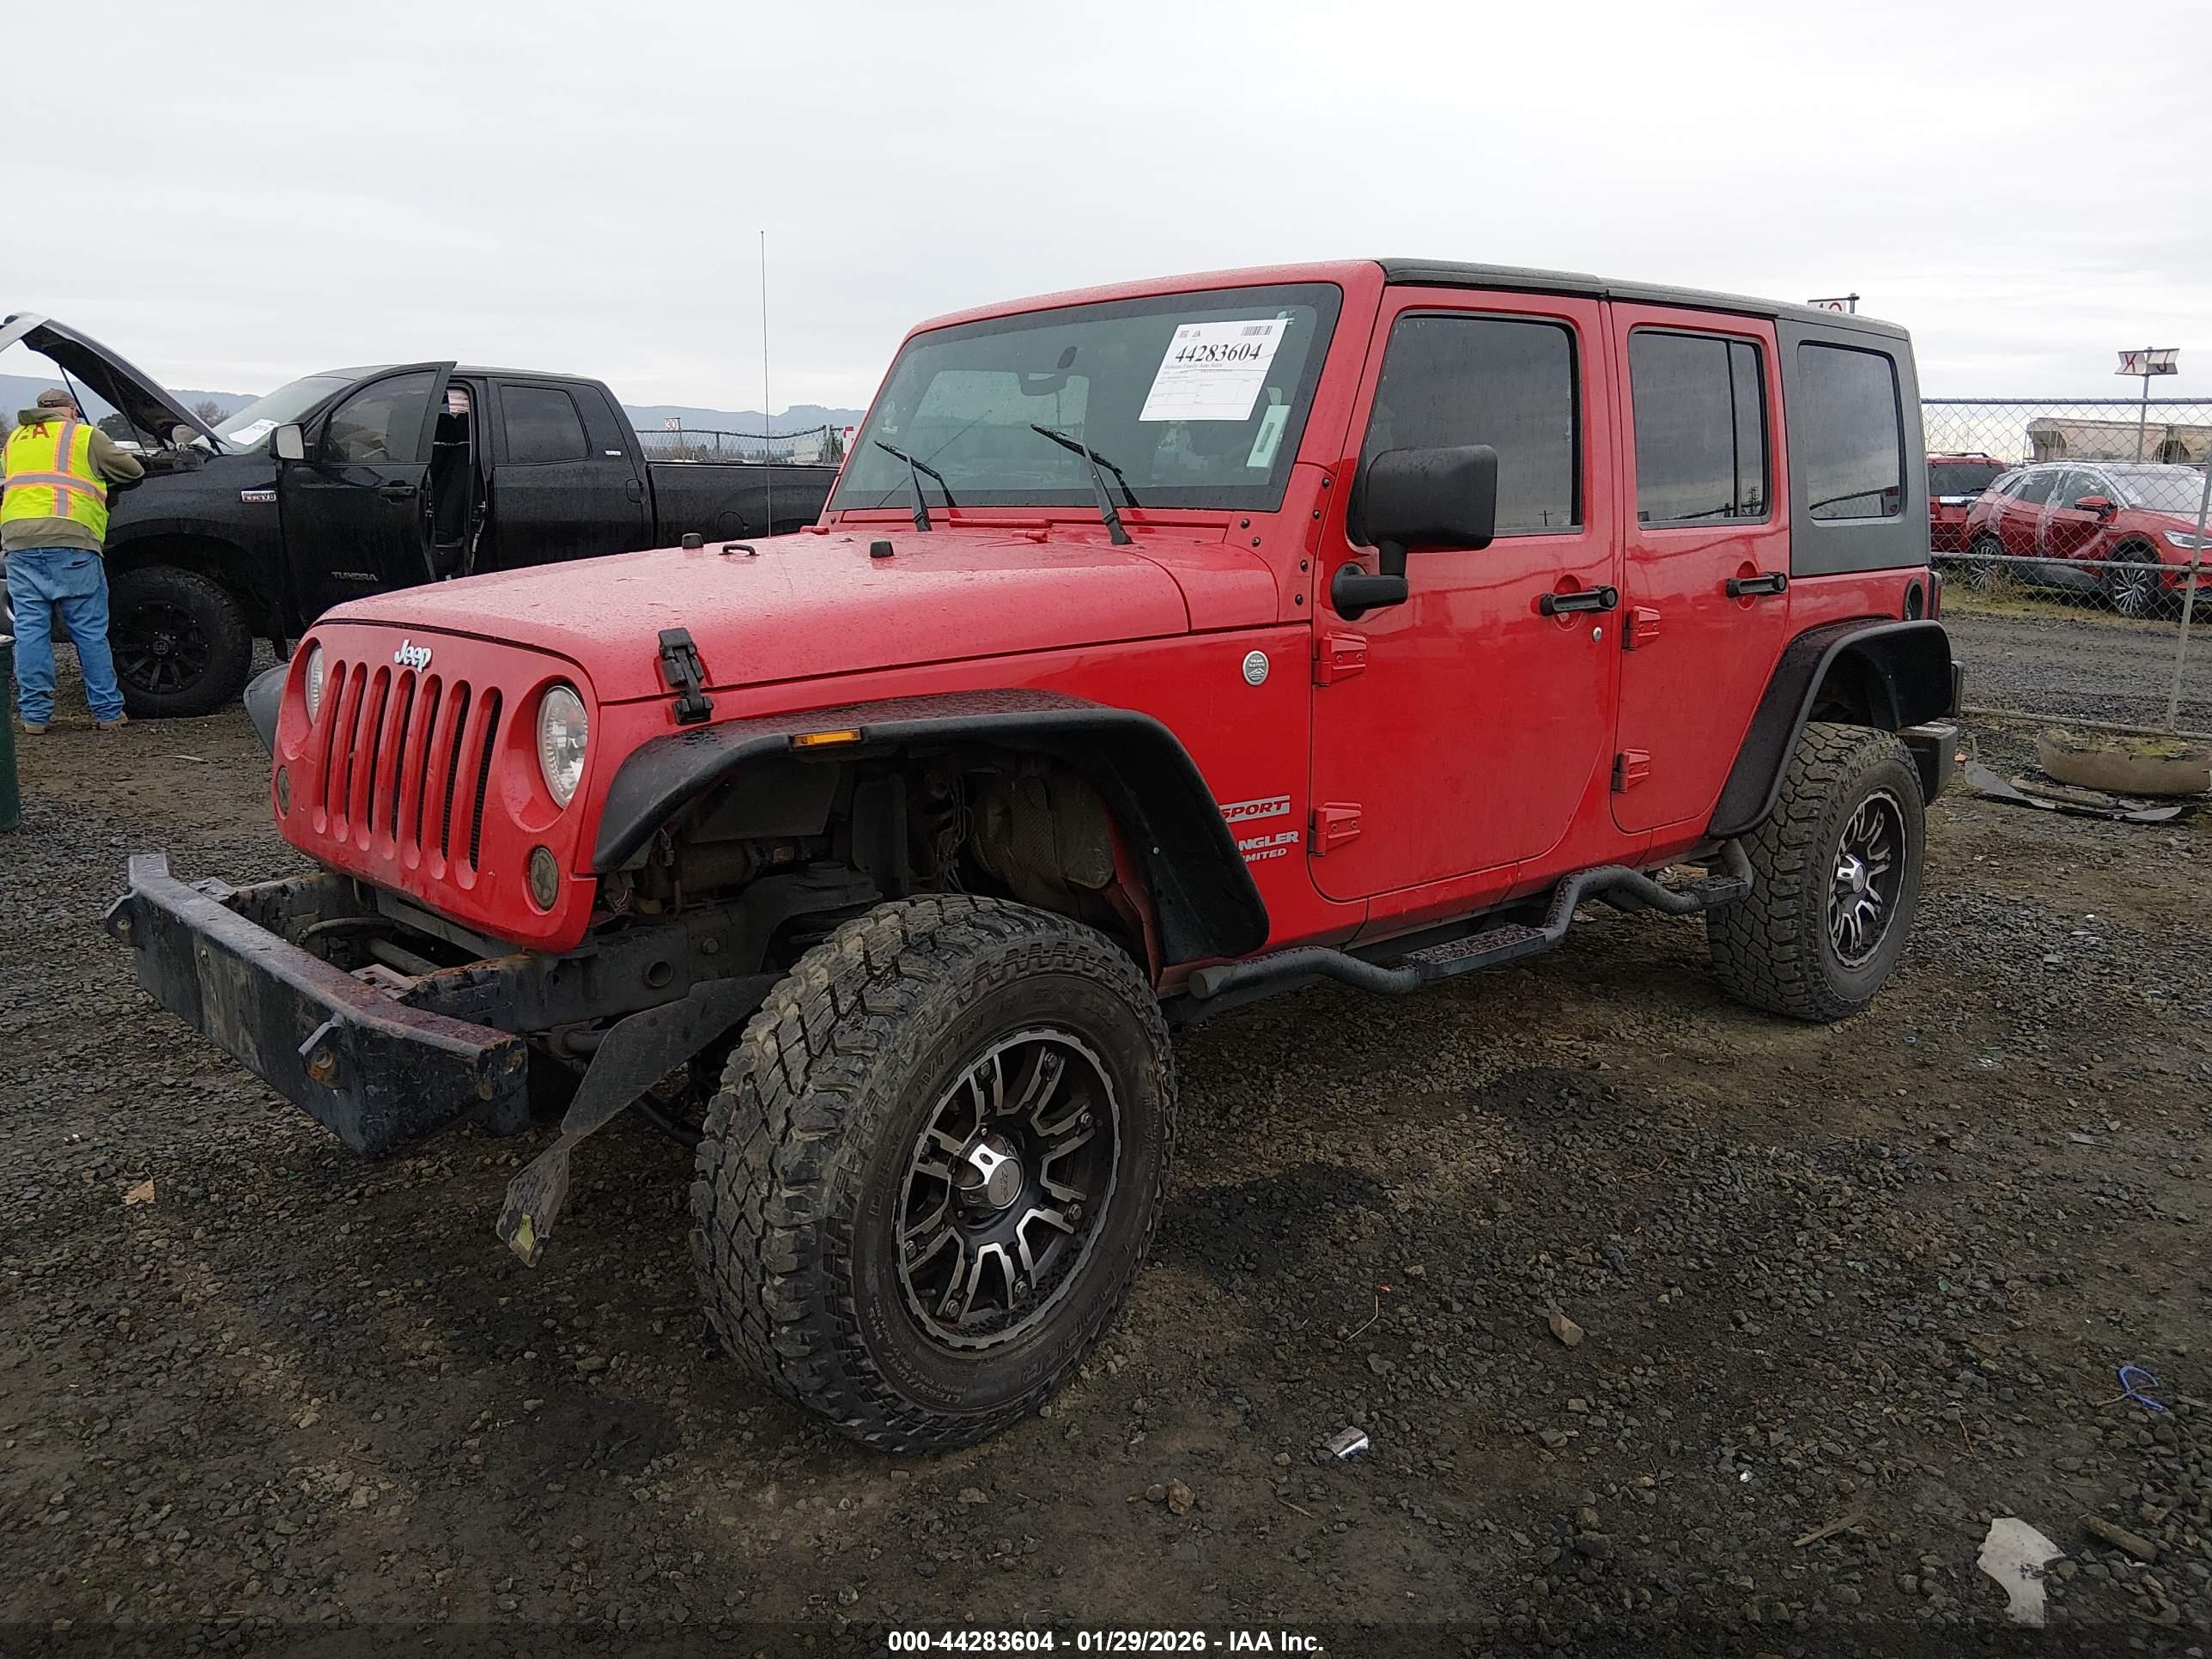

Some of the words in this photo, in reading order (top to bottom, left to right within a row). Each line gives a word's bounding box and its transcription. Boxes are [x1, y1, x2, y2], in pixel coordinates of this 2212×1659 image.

[1175, 343, 1262, 362] 44283604
[665, 419, 677, 430] 30
[331, 571, 379, 581] TUNDRA
[394, 639, 432, 673] Jeep
[1221, 799, 1284, 819] SPORT
